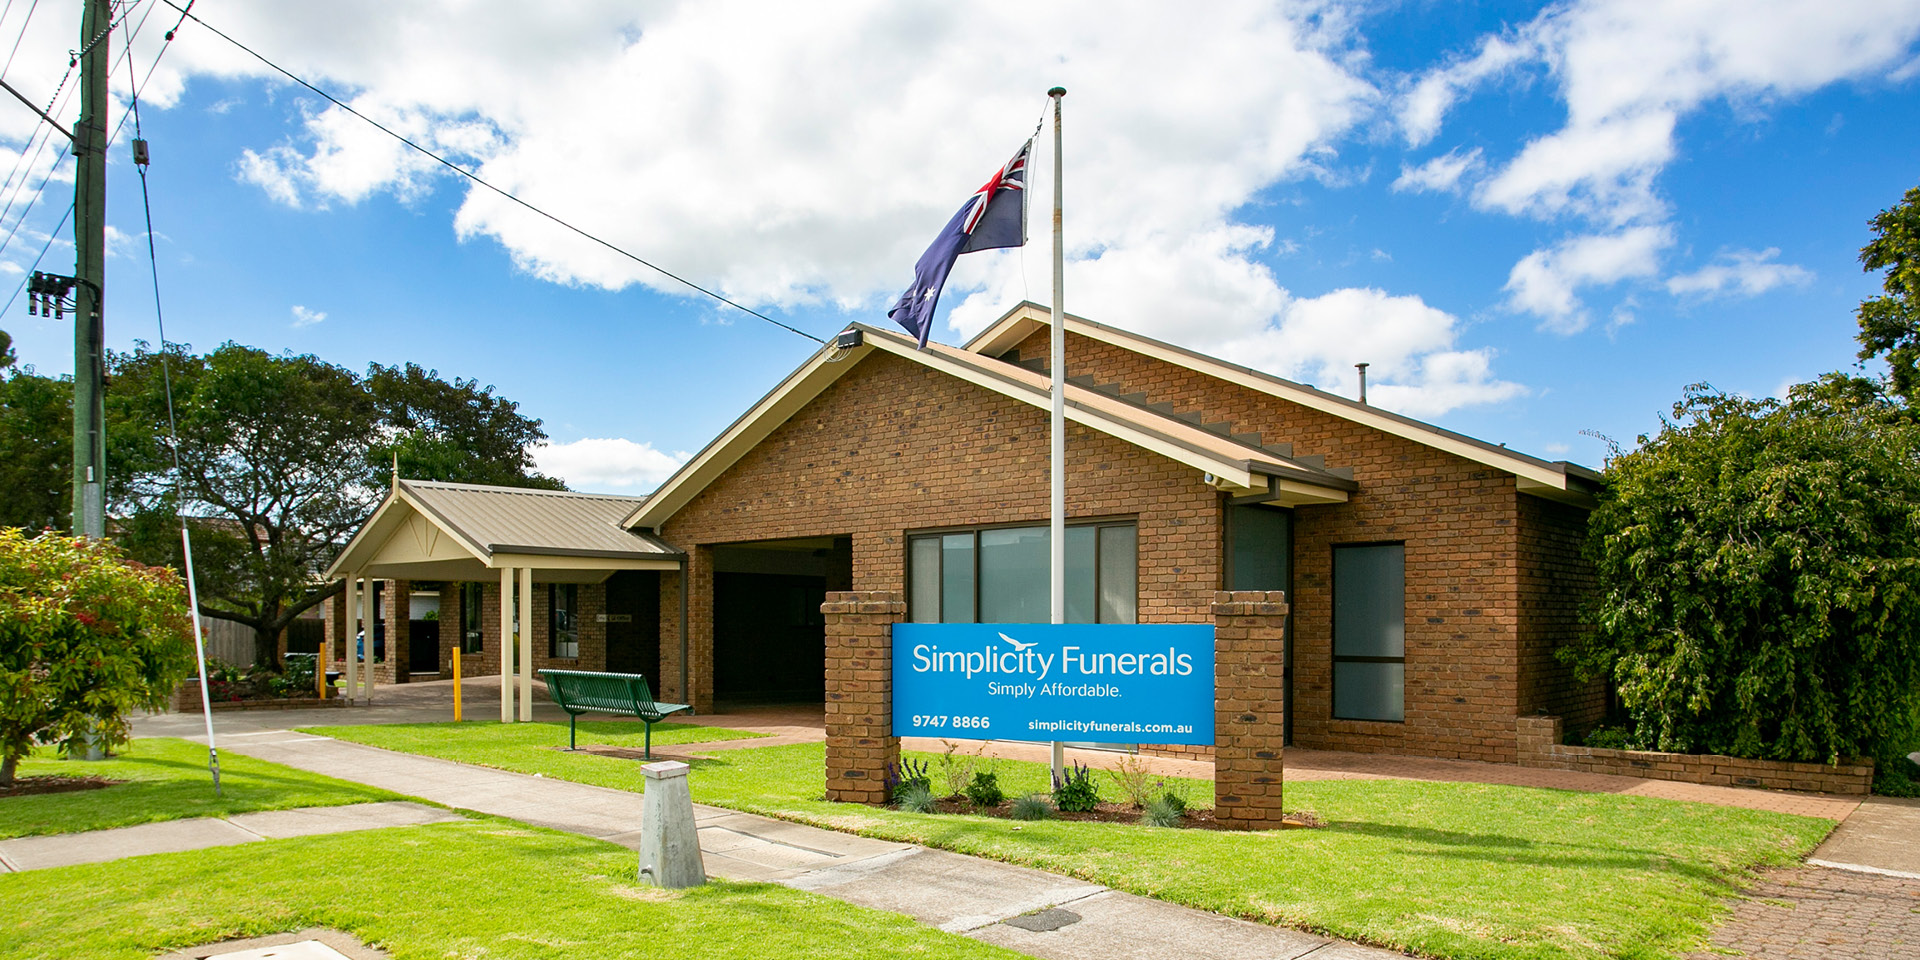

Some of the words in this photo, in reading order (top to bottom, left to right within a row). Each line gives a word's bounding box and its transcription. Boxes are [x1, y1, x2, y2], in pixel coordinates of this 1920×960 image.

[912, 644, 1055, 681] Simplicity
[1062, 646, 1193, 676] Funerals
[988, 681, 1036, 699] Simply
[1040, 683, 1122, 698] Affordable.
[912, 715, 948, 728] 9747
[952, 716, 990, 729] 8866
[1028, 719, 1193, 734] simplicityfunerals.com.au
